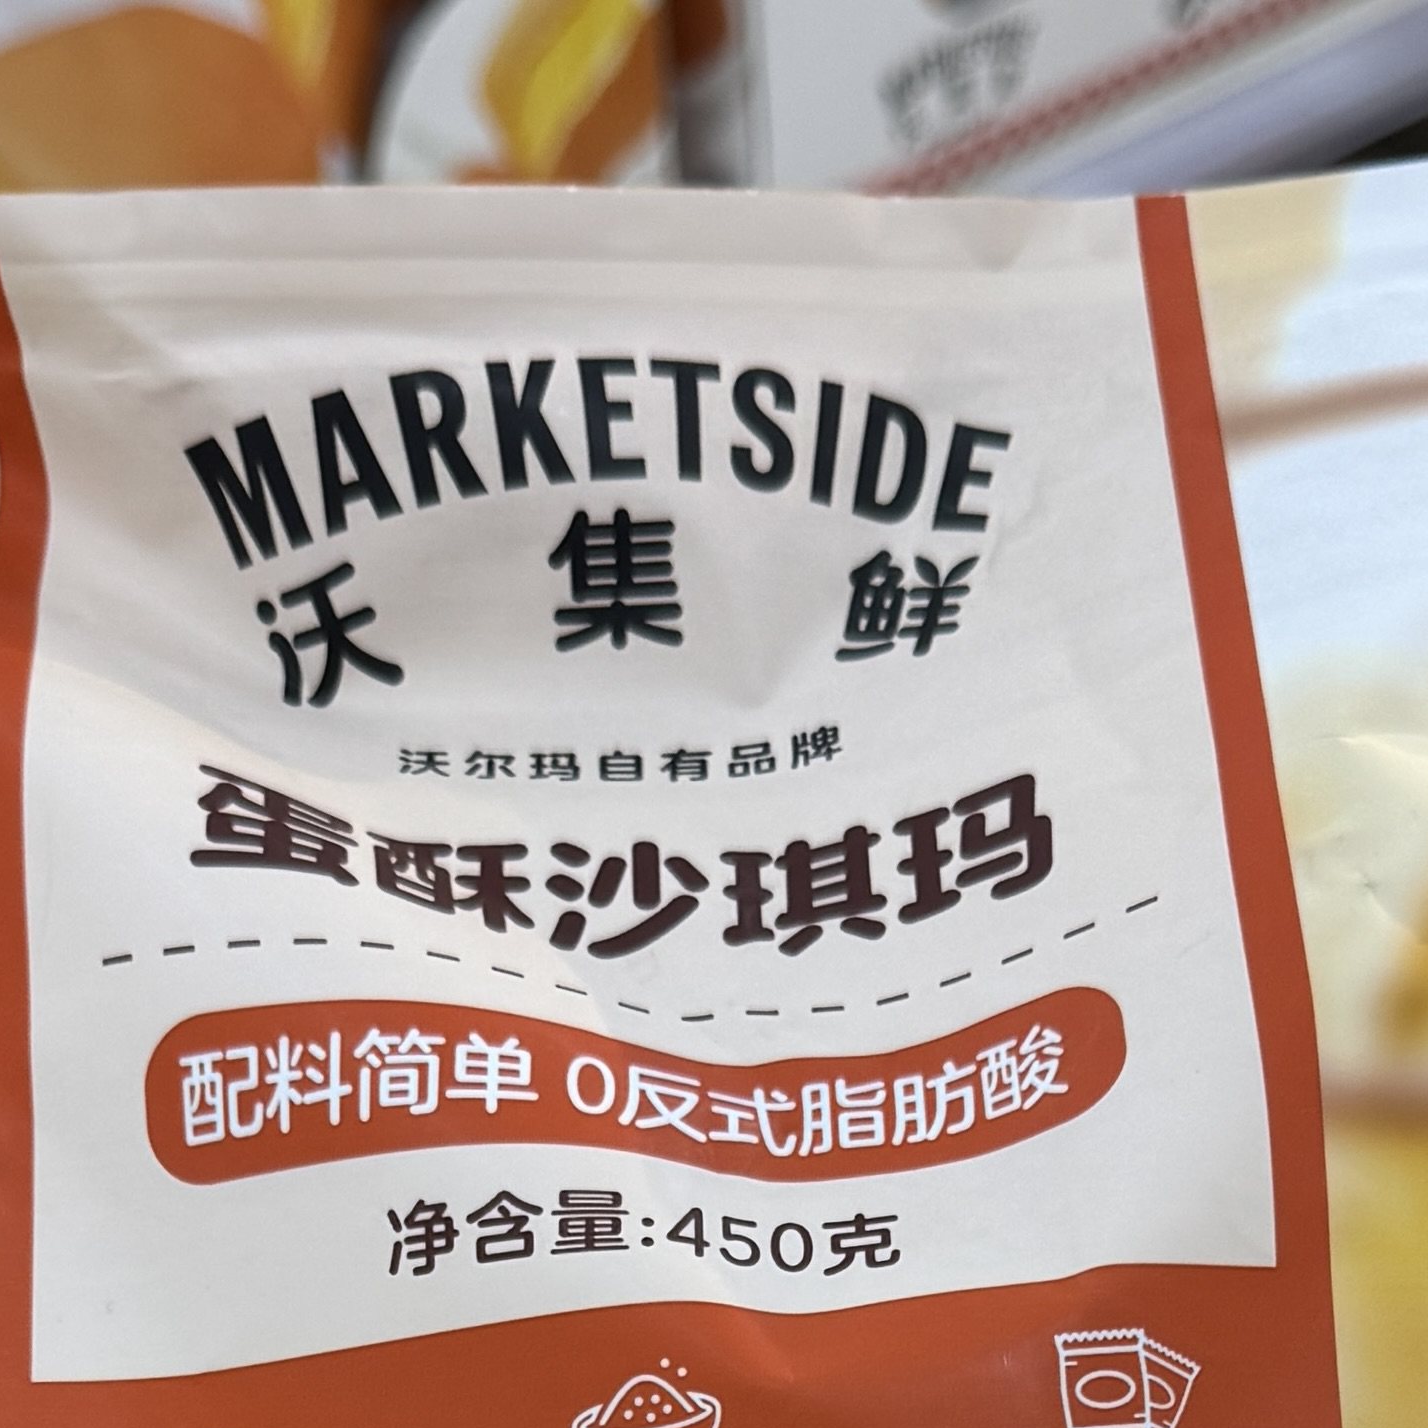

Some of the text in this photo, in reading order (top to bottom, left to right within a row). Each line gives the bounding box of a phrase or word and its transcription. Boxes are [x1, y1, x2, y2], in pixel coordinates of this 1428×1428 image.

[183, 357, 1011, 570] MARKETSIDE
[253, 507, 980, 708] 沃集鲜
[398, 725, 843, 783] 沃尔玛自有品牌
[189, 764, 1055, 958] 蛋酥沙琪玛
[178, 1024, 1070, 1158] 配料简单 0反式脂肪酸
[386, 1188, 902, 1277] 净含量:450克
